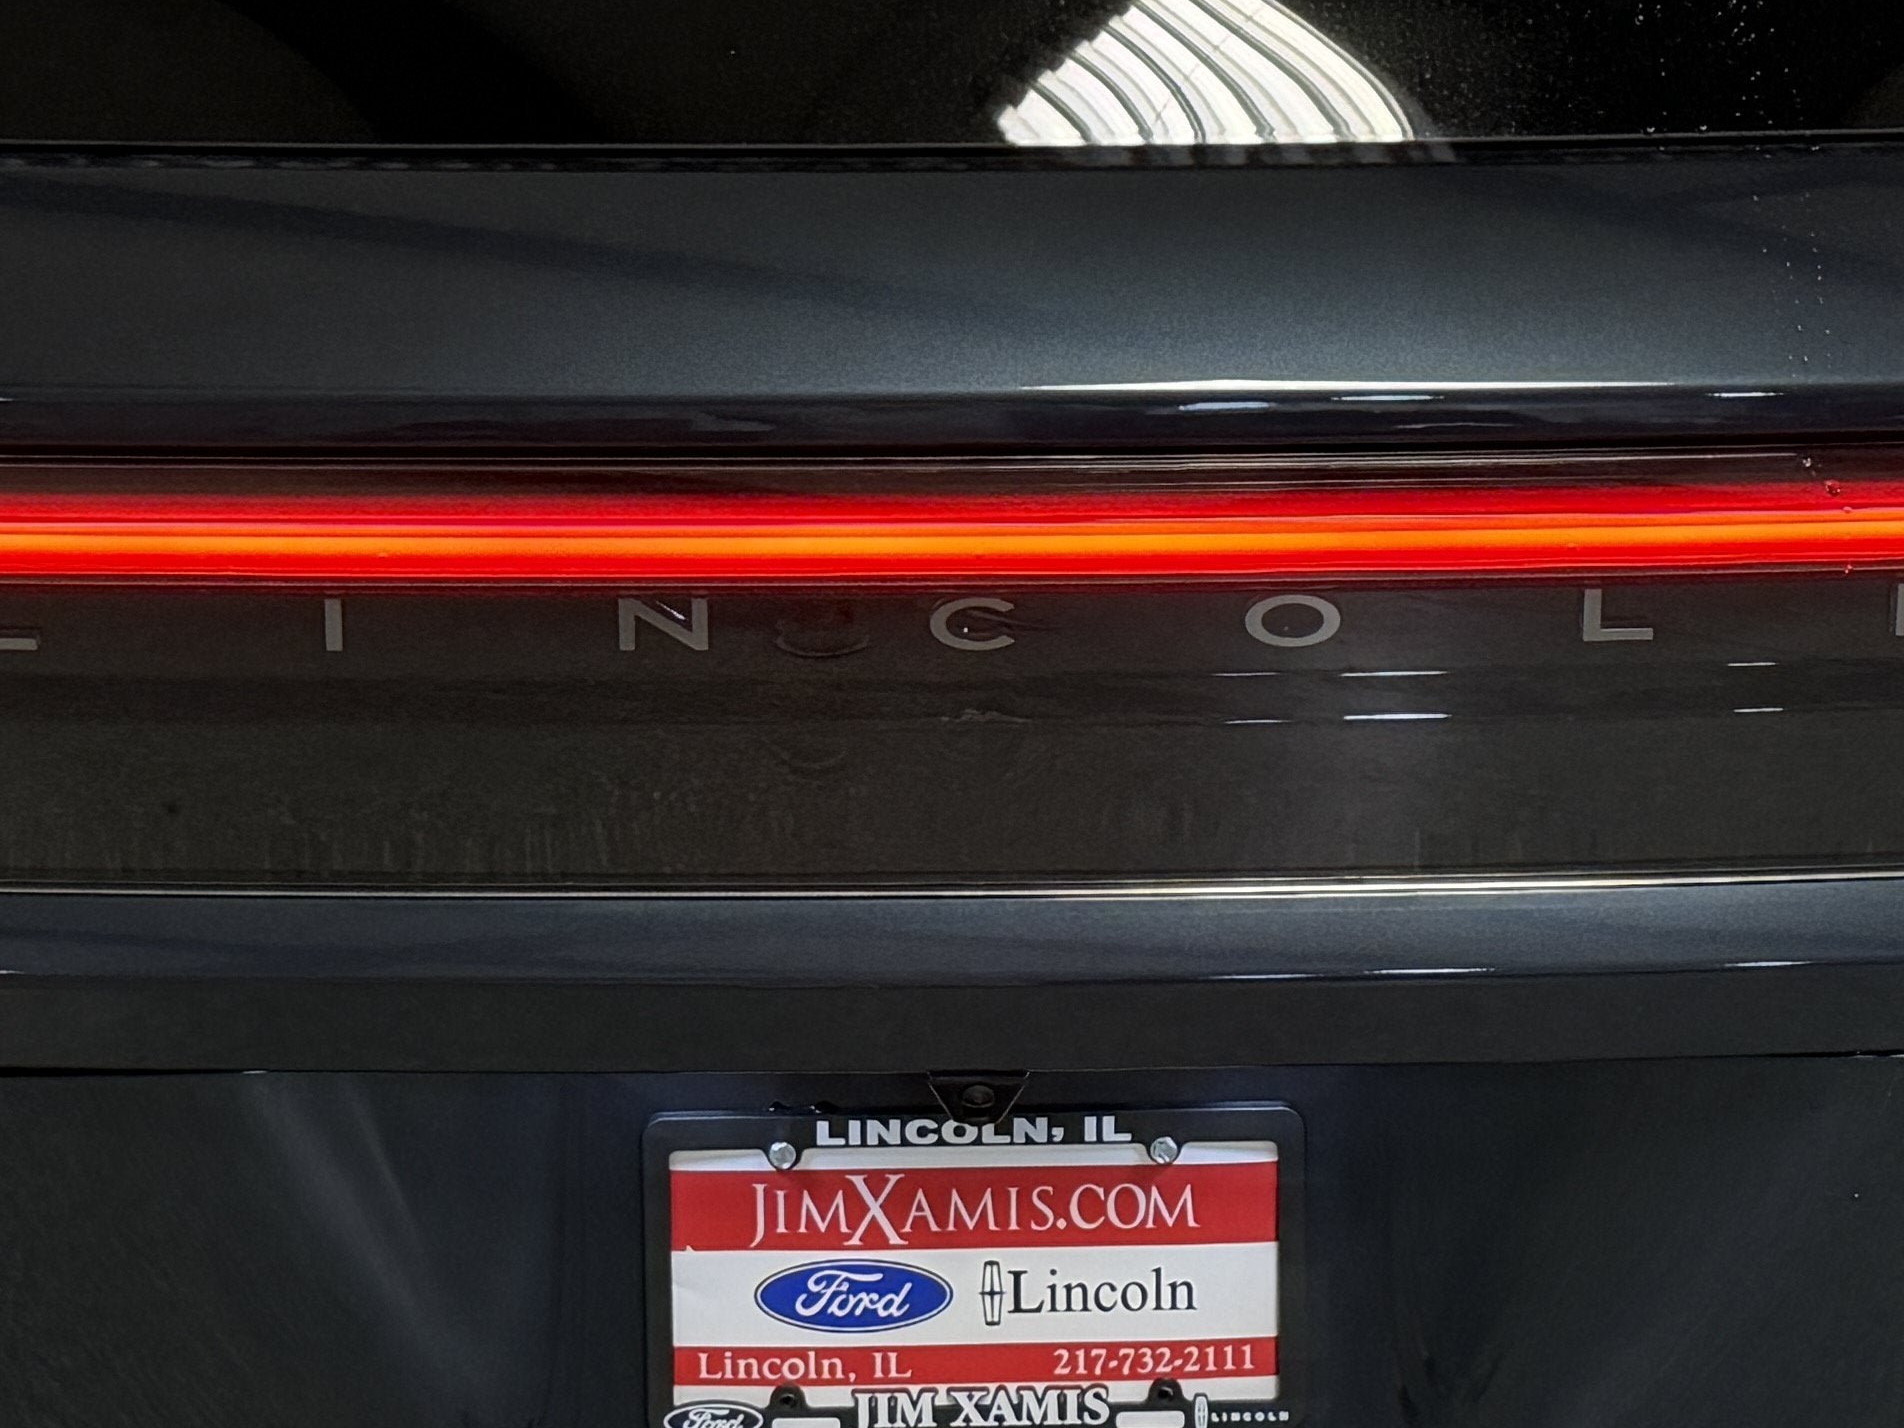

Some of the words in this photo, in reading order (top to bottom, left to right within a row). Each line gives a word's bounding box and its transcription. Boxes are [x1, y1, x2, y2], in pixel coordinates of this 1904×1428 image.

[816, 1117, 1065, 1146] LINCOLN,
[1084, 1115, 1132, 1142] IL
[749, 1173, 1200, 1248] JIMXAMIS.COM
[1007, 1267, 1197, 1314] Lincoln
[698, 1350, 856, 1383] Lincoln,
[872, 1351, 912, 1379] IL
[1053, 1345, 1255, 1376] 217-732-2111
[949, 1387, 1110, 1428] XAMIS
[1211, 1411, 1289, 1422] LINCOLN
